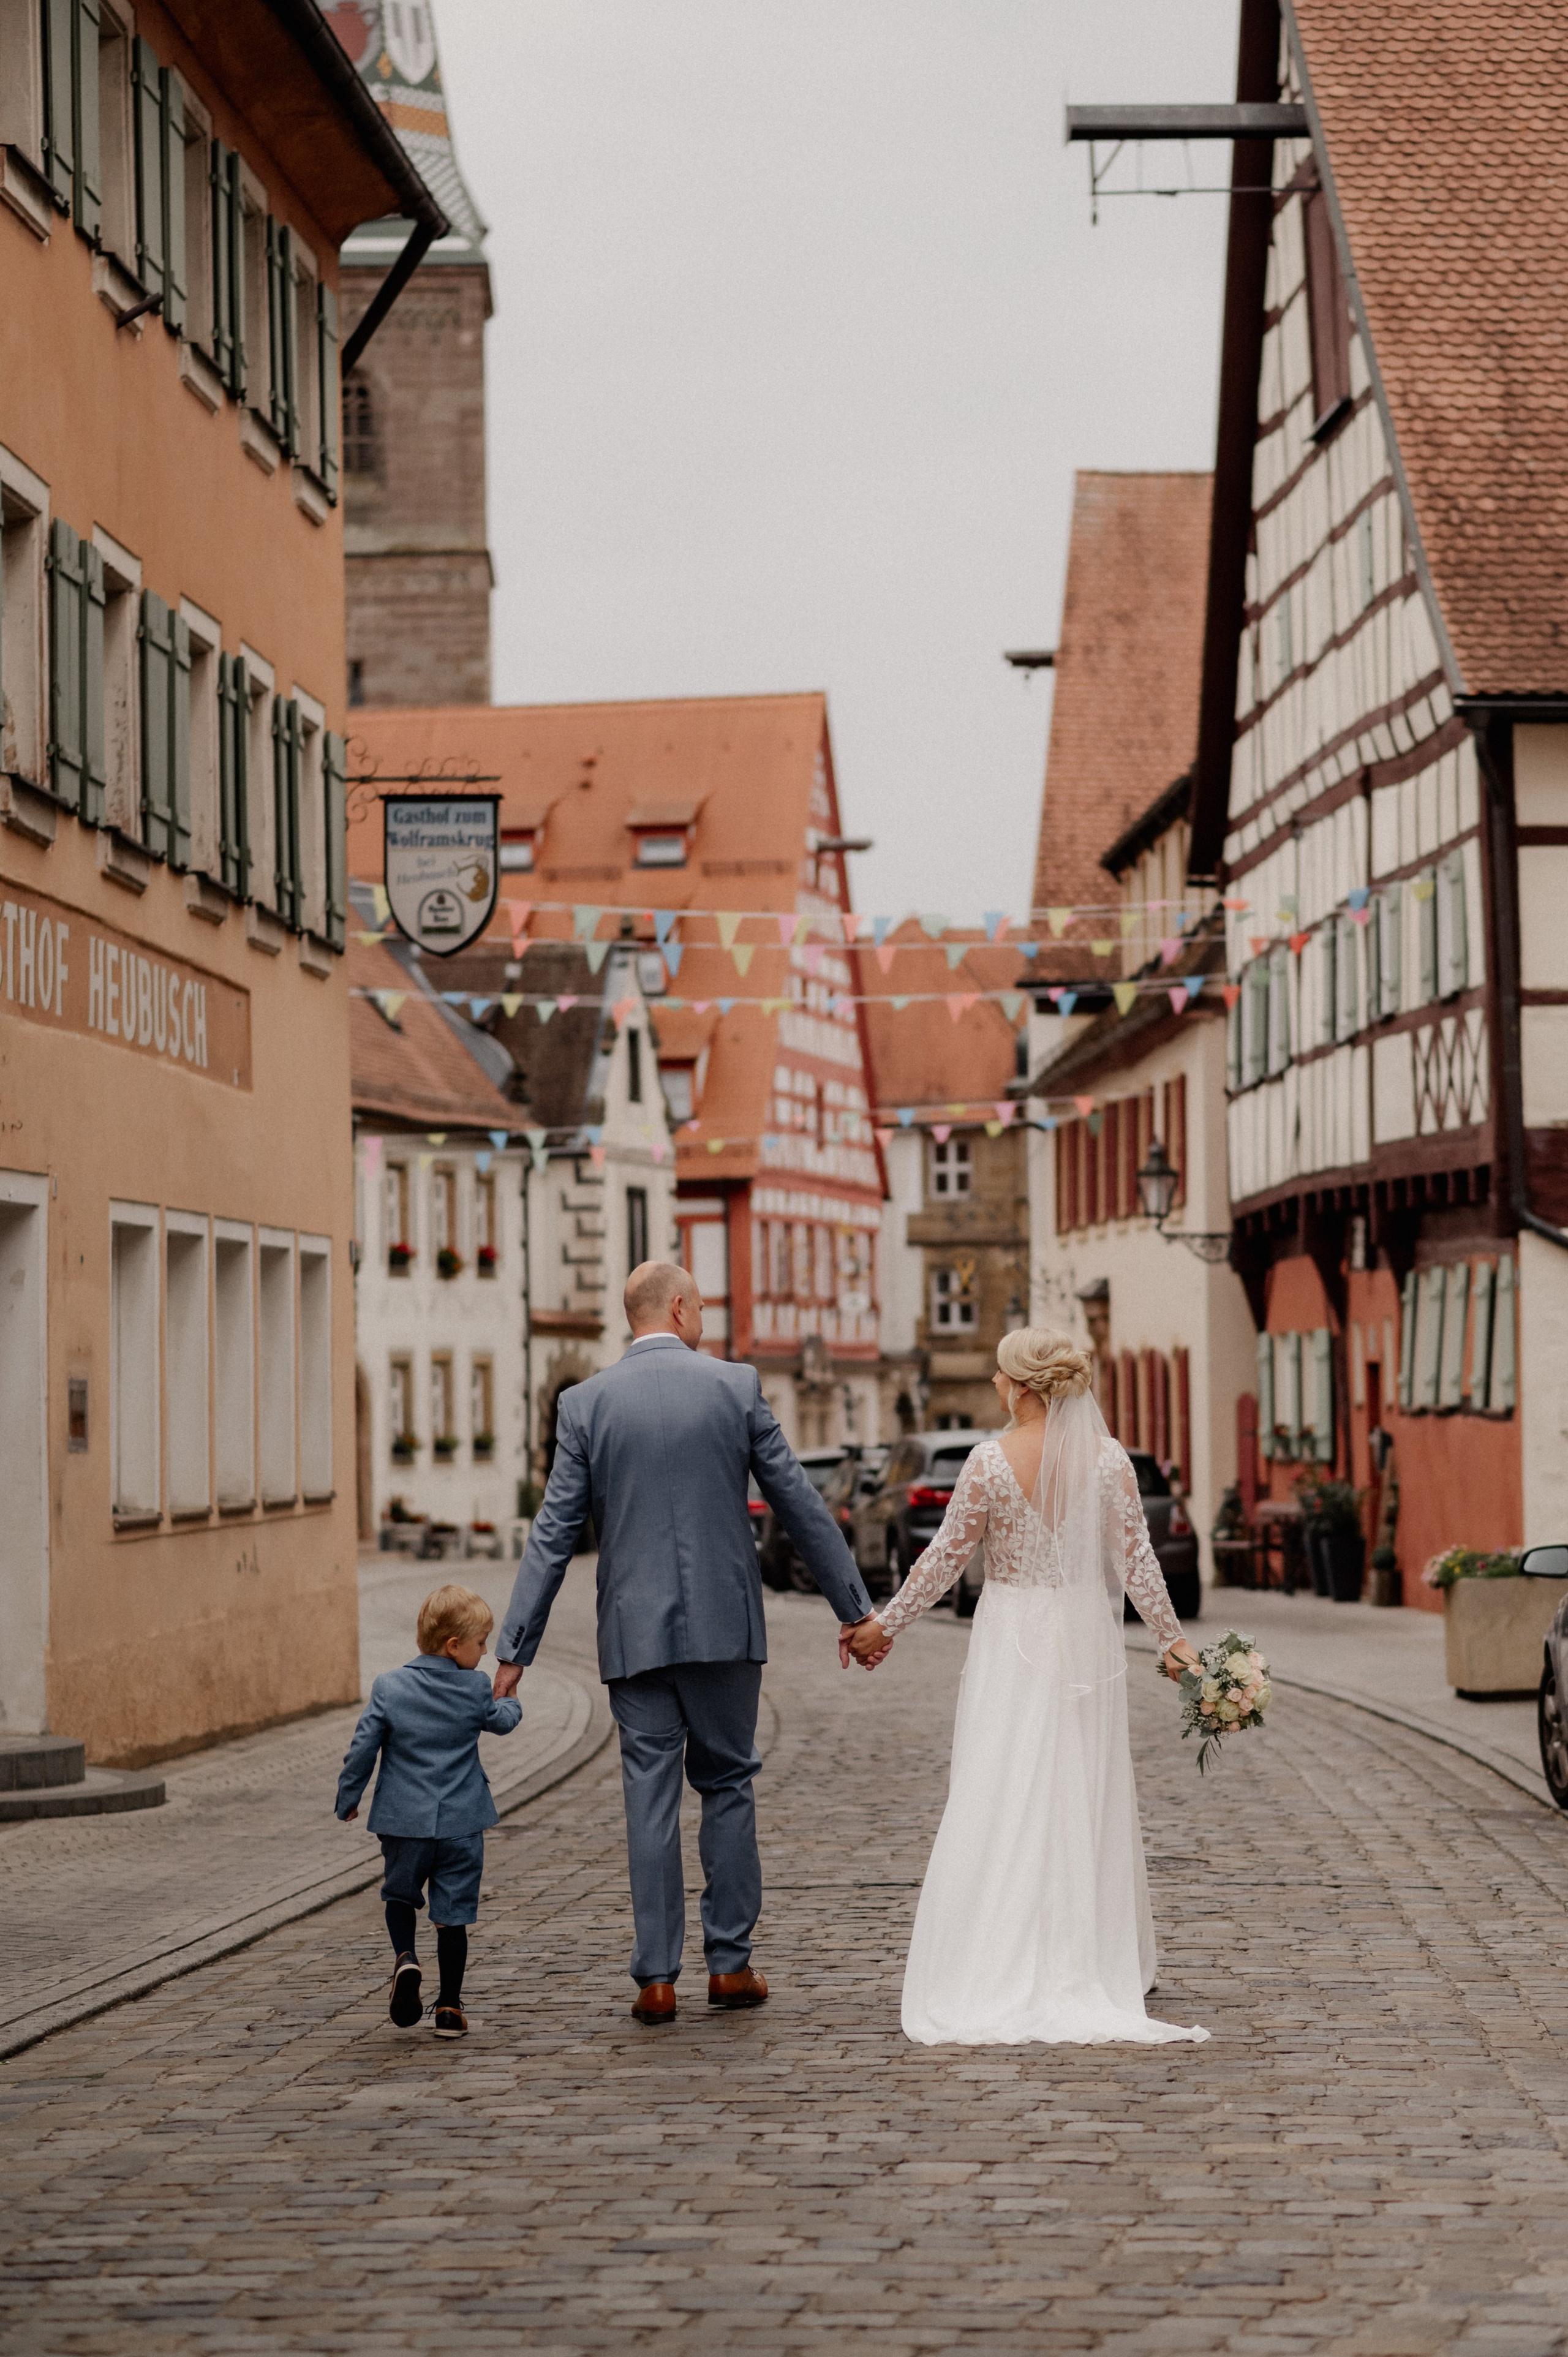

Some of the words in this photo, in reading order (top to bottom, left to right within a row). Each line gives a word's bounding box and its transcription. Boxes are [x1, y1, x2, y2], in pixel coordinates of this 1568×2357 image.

[393, 806, 450, 824] Gasthof
[455, 811, 486, 824] zum
[0, 901, 69, 1016] THOF
[88, 935, 208, 1068] HEUBUSCH
